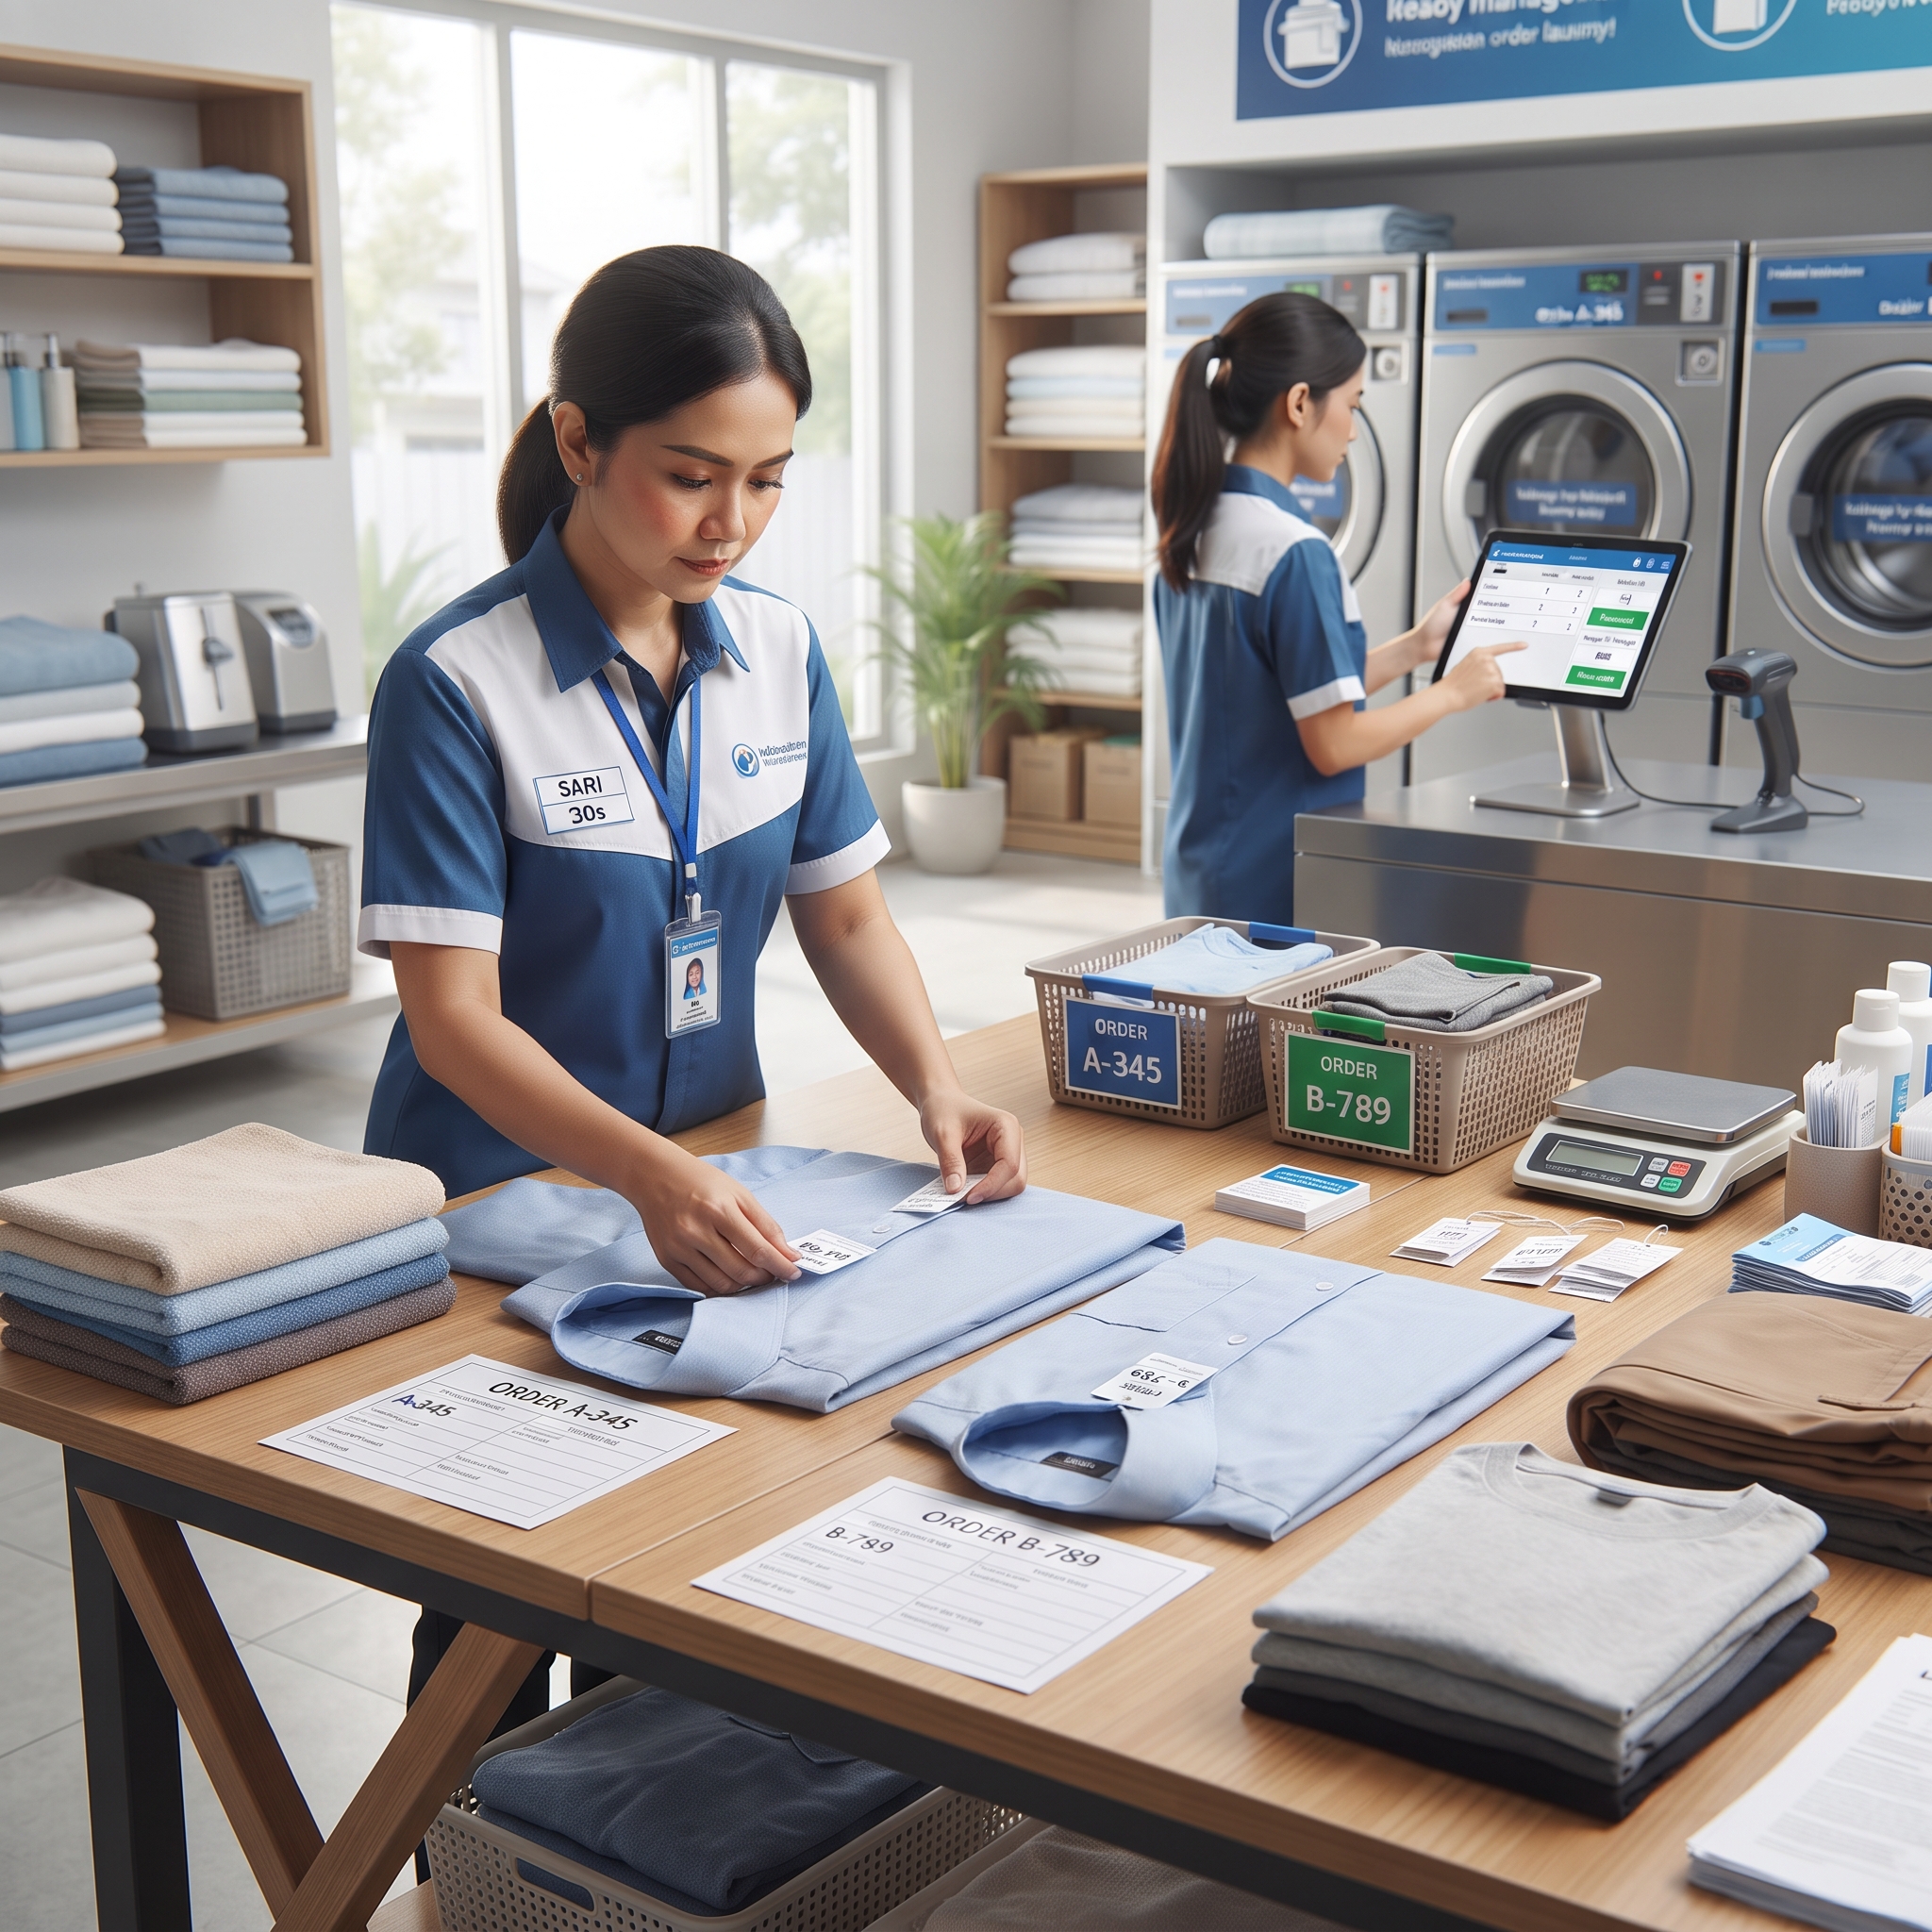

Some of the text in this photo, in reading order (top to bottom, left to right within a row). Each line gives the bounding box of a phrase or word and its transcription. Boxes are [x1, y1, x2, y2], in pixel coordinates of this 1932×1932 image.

[558, 775, 603, 797] SARI
[569, 805, 606, 824] 30s
[1095, 1018, 1148, 1041] ORDER
[1083, 1046, 1162, 1084] A-345
[1321, 1056, 1377, 1080] ORDER
[1307, 1084, 1391, 1125] B-789
[489, 1382, 569, 1411] ORDER
[563, 1404, 639, 1430] A-345
[825, 1526, 894, 1554] B-789
[922, 1510, 1017, 1544] ORDER
[1017, 1537, 1101, 1567] B-789
